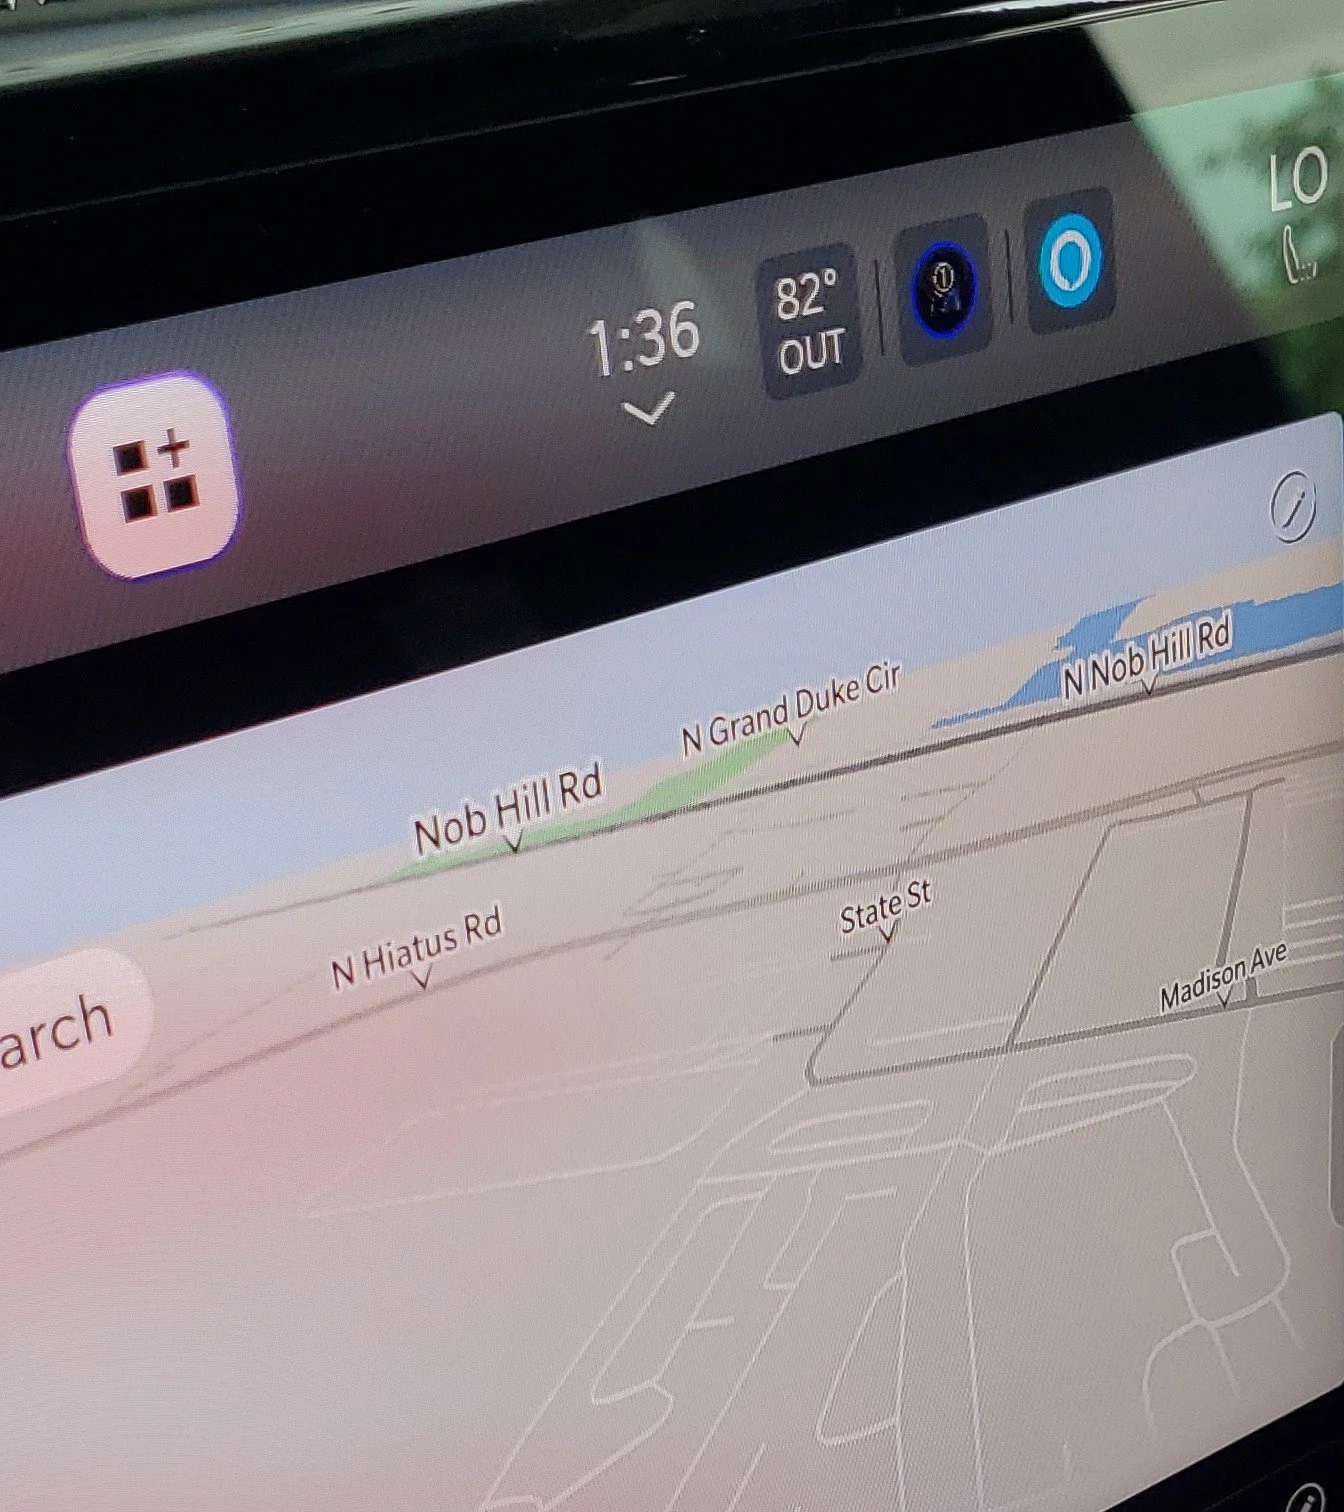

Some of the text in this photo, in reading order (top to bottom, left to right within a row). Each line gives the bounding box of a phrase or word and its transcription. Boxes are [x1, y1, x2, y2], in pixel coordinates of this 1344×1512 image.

[1270, 146, 1328, 213] LO
[777, 268, 840, 321] 82°
[590, 301, 701, 377] 1:36
[779, 328, 846, 377] OUT
[1063, 618, 1230, 700] N Nob Hill Rd
[682, 661, 902, 758] N Grand Duke Cir
[415, 761, 602, 855] Nob Hill Rd
[840, 879, 932, 935] State St
[332, 905, 503, 990] N Hiatus Rd
[1161, 942, 1288, 1012] Madison Ave
